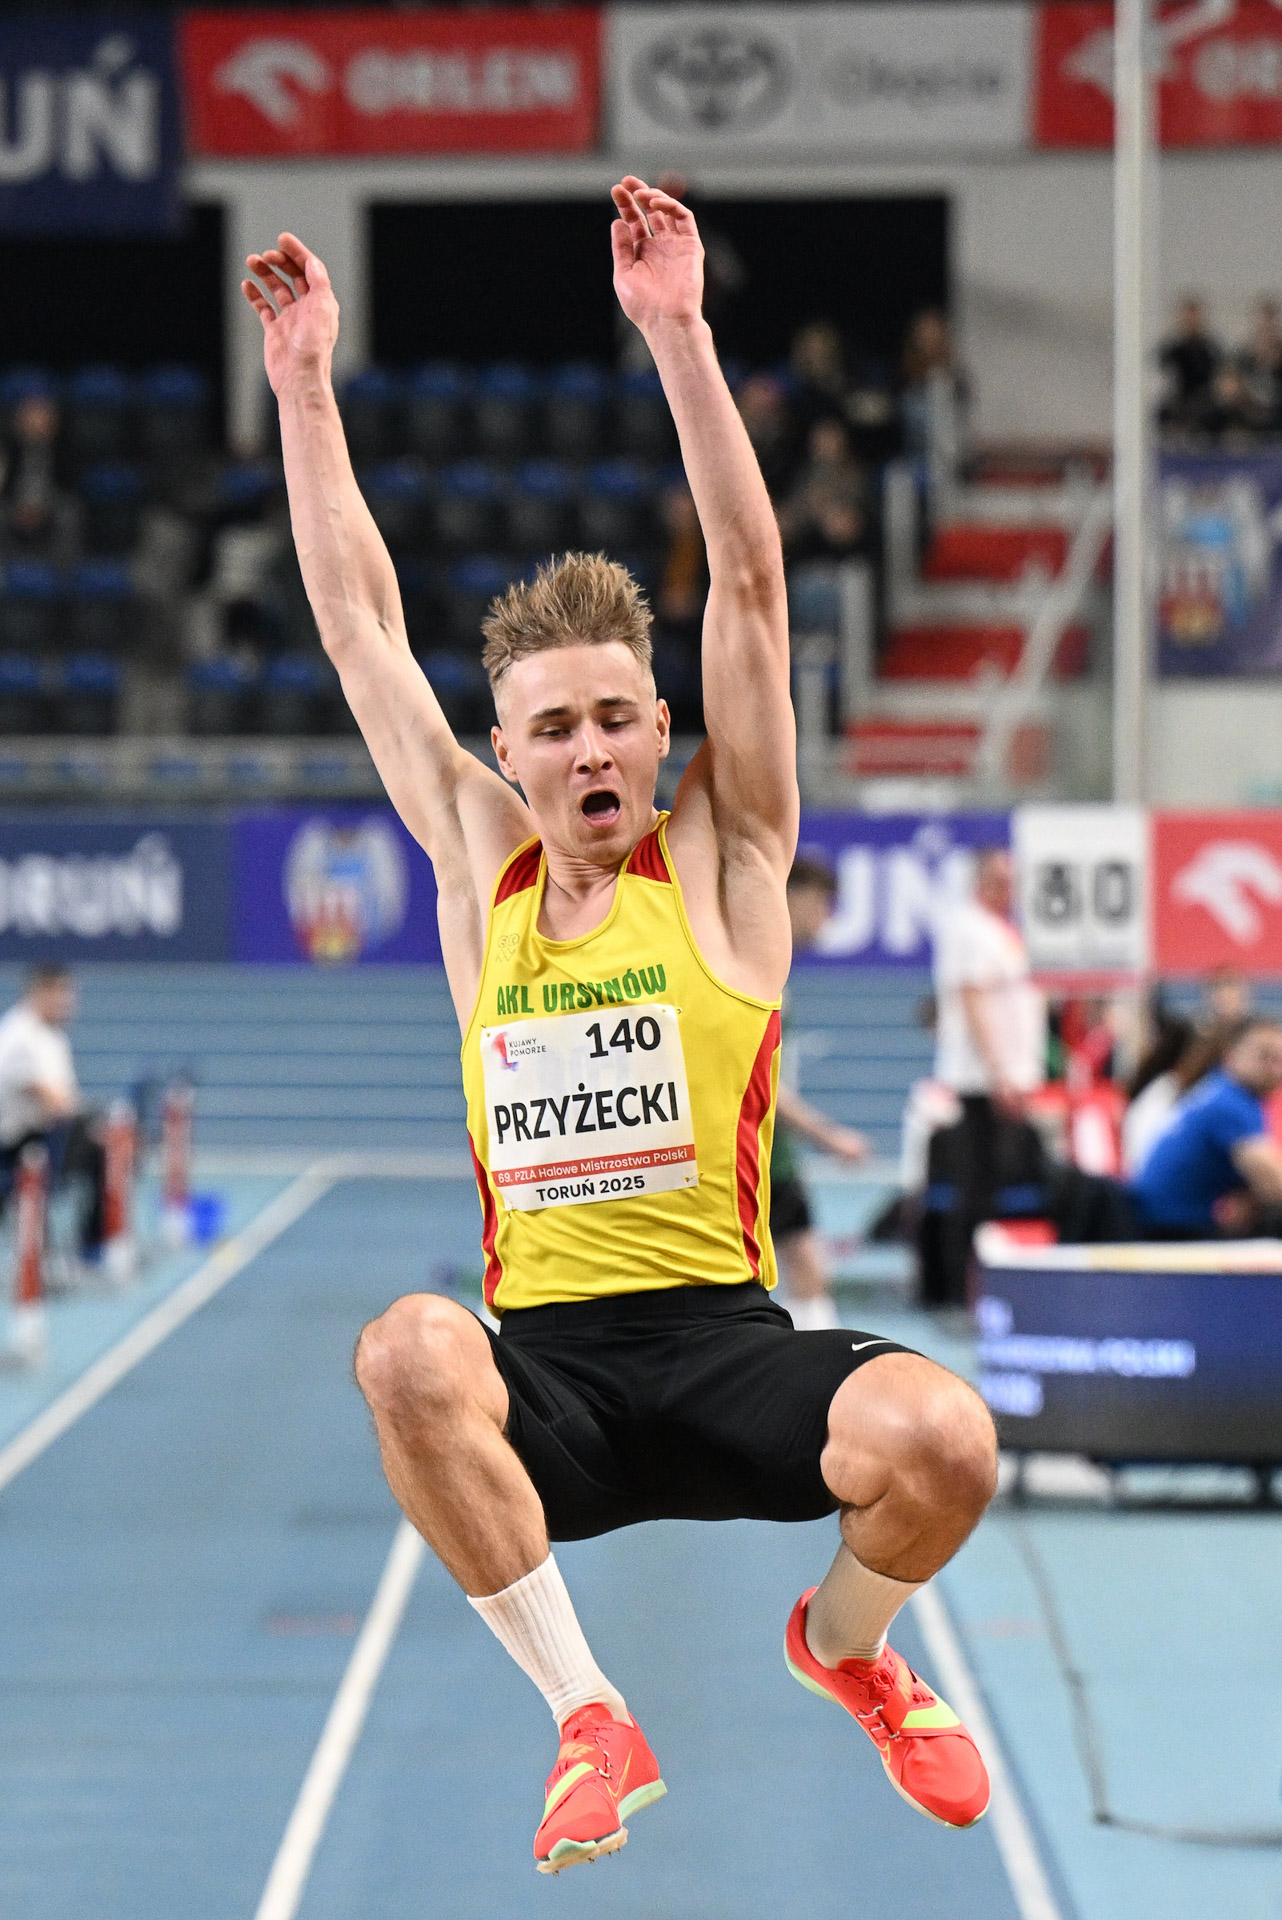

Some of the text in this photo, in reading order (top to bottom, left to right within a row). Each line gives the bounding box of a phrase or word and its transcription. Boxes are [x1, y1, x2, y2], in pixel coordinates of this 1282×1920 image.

[1033, 858, 1133, 926] 80
[497, 964, 667, 1016] AKL URSYNÓW
[509, 1038, 537, 1047] KUJAWY
[510, 1045, 547, 1057] POMORZE
[585, 1016, 661, 1058] 140
[494, 1082, 679, 1144] PRZYŻECKI
[498, 1147, 688, 1184] 69. PZLA Halowe Mistrzostwa Polski
[536, 1175, 646, 1202] TORUŃ 2025
